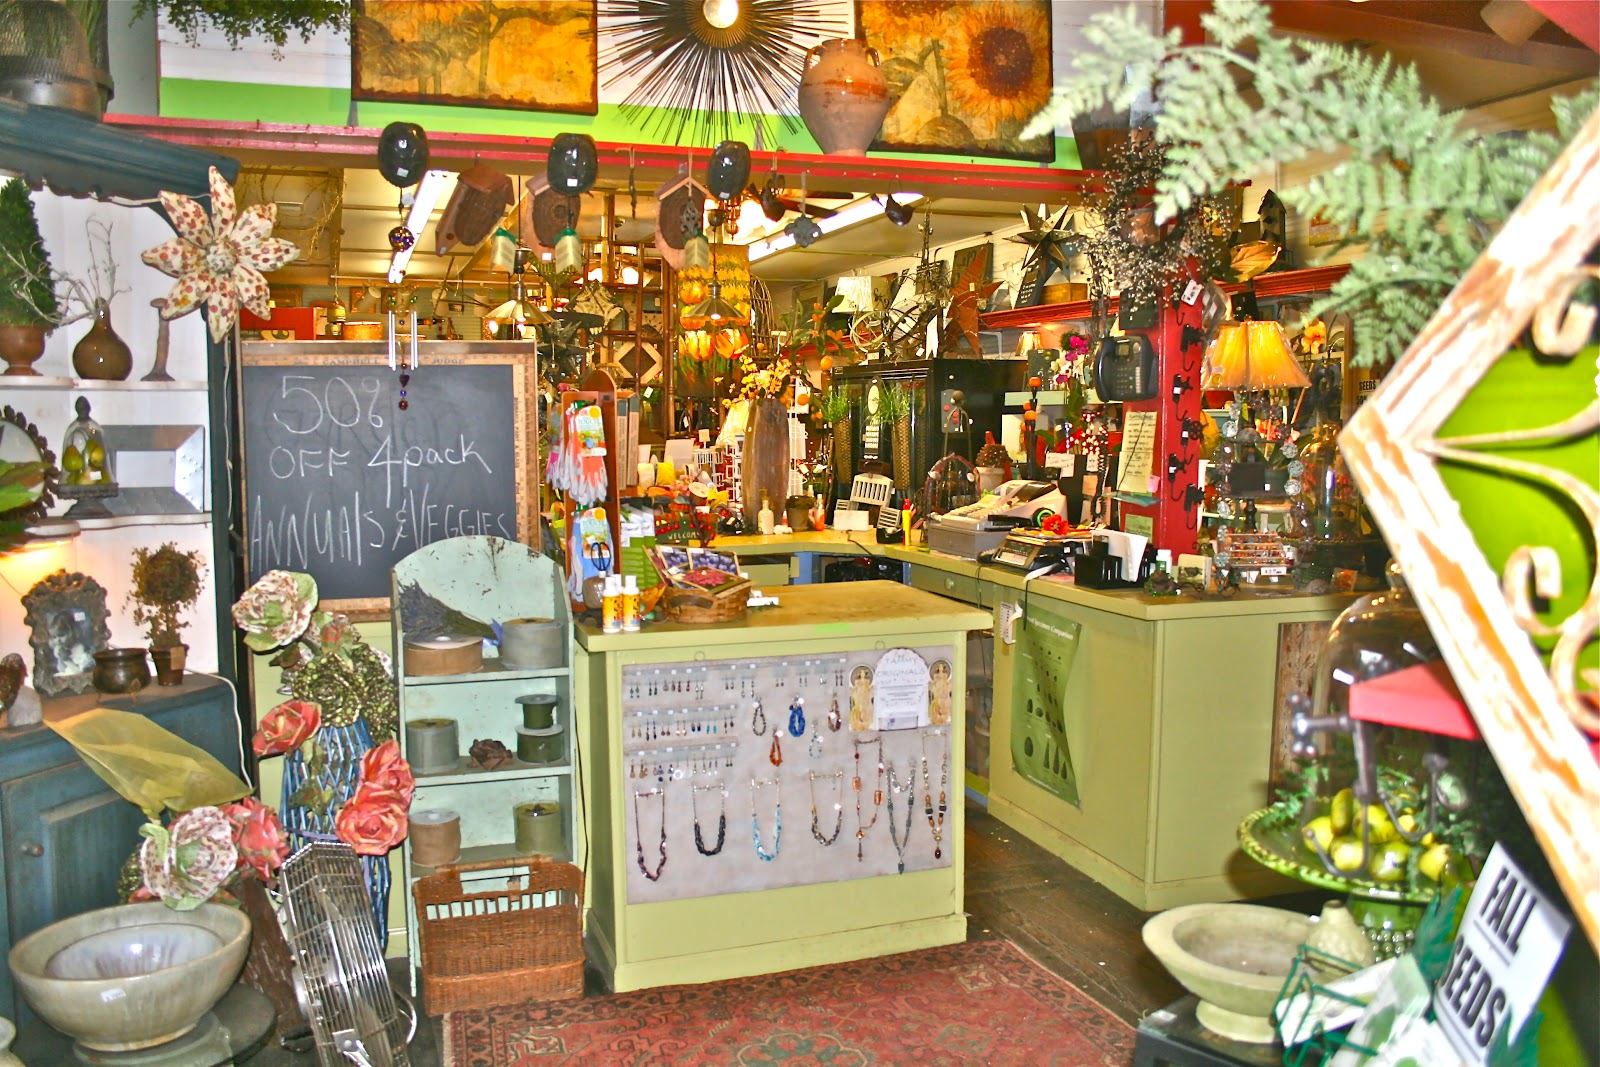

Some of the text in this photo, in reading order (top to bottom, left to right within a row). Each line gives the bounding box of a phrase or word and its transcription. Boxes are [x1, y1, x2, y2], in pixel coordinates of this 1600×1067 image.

[1359, 380, 1376, 391] SEEDS
[269, 445, 351, 479] OFF
[667, 530, 700, 540] WELCOM
[1479, 866, 1538, 956] FALL
[1438, 934, 1507, 1048] SEEDS
